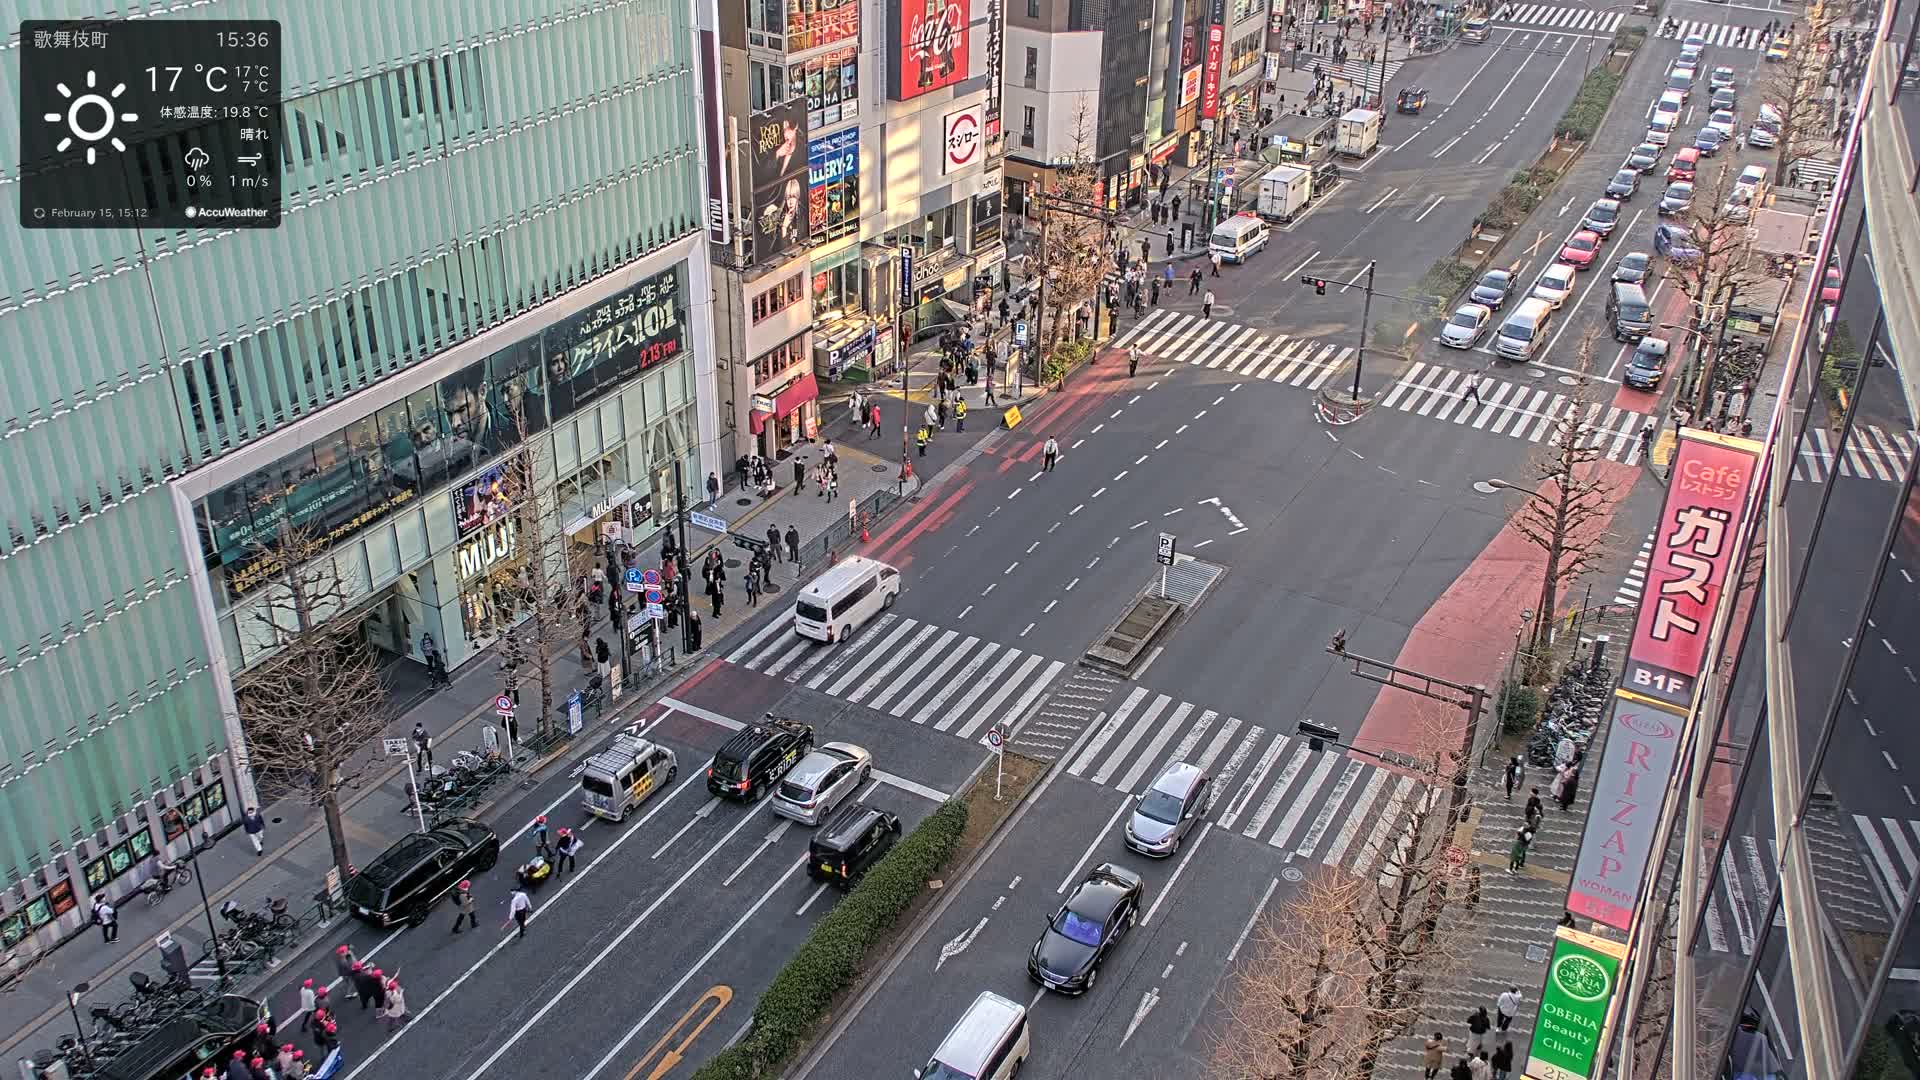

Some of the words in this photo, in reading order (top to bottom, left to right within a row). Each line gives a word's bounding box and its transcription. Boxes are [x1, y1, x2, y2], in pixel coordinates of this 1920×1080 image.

[1206, 44, 1220, 109] バーガーキング
[947, 132, 979, 150] スシロー
[809, 153, 855, 186] ALLERY-2
[710, 198, 723, 232] MUJI
[1017, 324, 1025, 333] P
[640, 343, 661, 368] 2.13
[662, 338, 677, 356] FRI
[1683, 459, 1741, 488] Café
[1680, 478, 1737, 500] レストラン
[592, 496, 615, 519] MUJI
[459, 521, 515, 580] MUJI
[1160, 538, 1169, 547] P
[1650, 506, 1732, 641] ガスト
[1633, 667, 1685, 695] B1F
[1597, 741, 1652, 880] RIZAP
[1579, 878, 1633, 903] WOMAN
[1559, 968, 1600, 989] OBERIA
[1543, 1003, 1598, 1031] OBERIA
[1543, 1018, 1591, 1045] Beauty
[1542, 1037, 1584, 1060] Clinic
[1544, 1066, 1569, 1080] 2F
